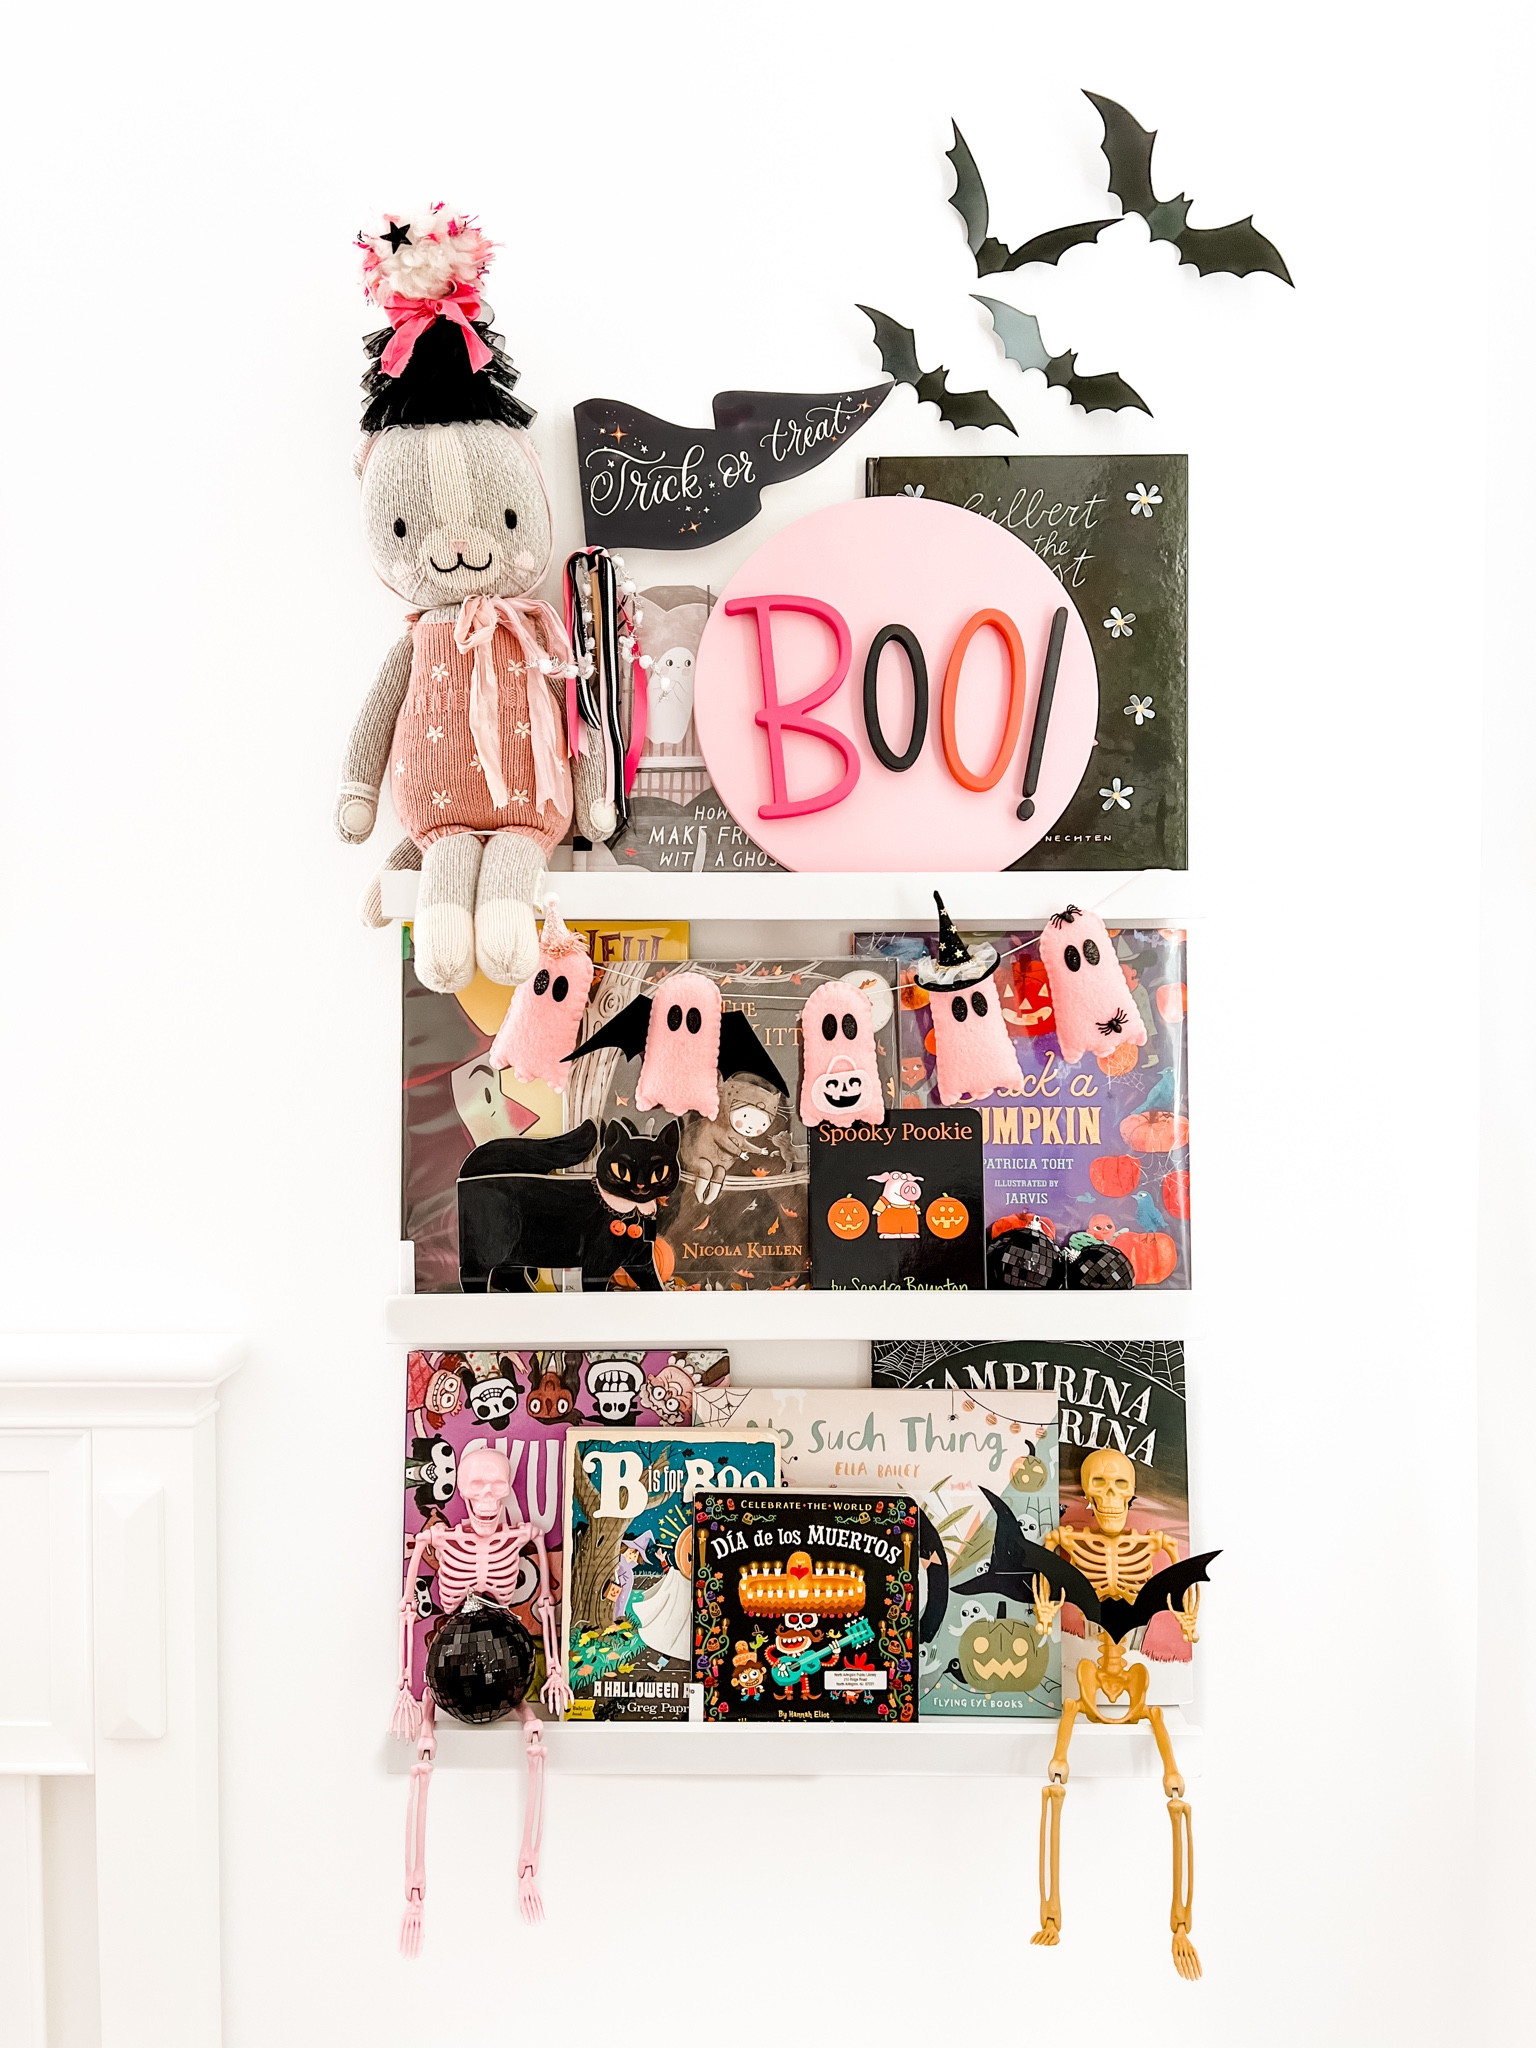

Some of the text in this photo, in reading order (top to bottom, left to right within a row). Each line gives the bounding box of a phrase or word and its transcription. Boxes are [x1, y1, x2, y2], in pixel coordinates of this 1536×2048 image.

[586, 401, 862, 516] Trick or treat
[1033, 530, 1071, 557] the
[725, 595, 1068, 821] BOO!
[694, 805, 729, 821] HOW
[660, 851, 695, 867] WIT
[715, 851, 725, 867] A
[1069, 1074, 1099, 1098] a
[819, 1122, 973, 1146] Spooky Pookie
[979, 1106, 1102, 1145] UMPKIN
[1041, 1158, 1074, 1170] TOHT
[994, 1179, 1059, 1188] ILLUSTRATED BY
[1005, 1193, 1048, 1205] JARVIS
[682, 1241, 803, 1259] NICOLA KILLEN
[808, 1411, 886, 1454] Such
[900, 1412, 1008, 1472] Thing
[835, 1461, 920, 1479] ELLA BAILEY
[582, 1451, 649, 1519] B
[648, 1465, 660, 1493] is
[664, 1467, 684, 1493] for
[710, 1524, 903, 1565] DÍA de los MUERTOS
[593, 1680, 602, 1697] A
[604, 1680, 679, 1699] HALLOWEEN
[616, 1702, 626, 1714] by
[627, 1702, 658, 1714] Greg
[933, 1697, 1024, 1709] FLYING EYE BOOKS
[778, 1709, 830, 1719] By Hannah Eliot
